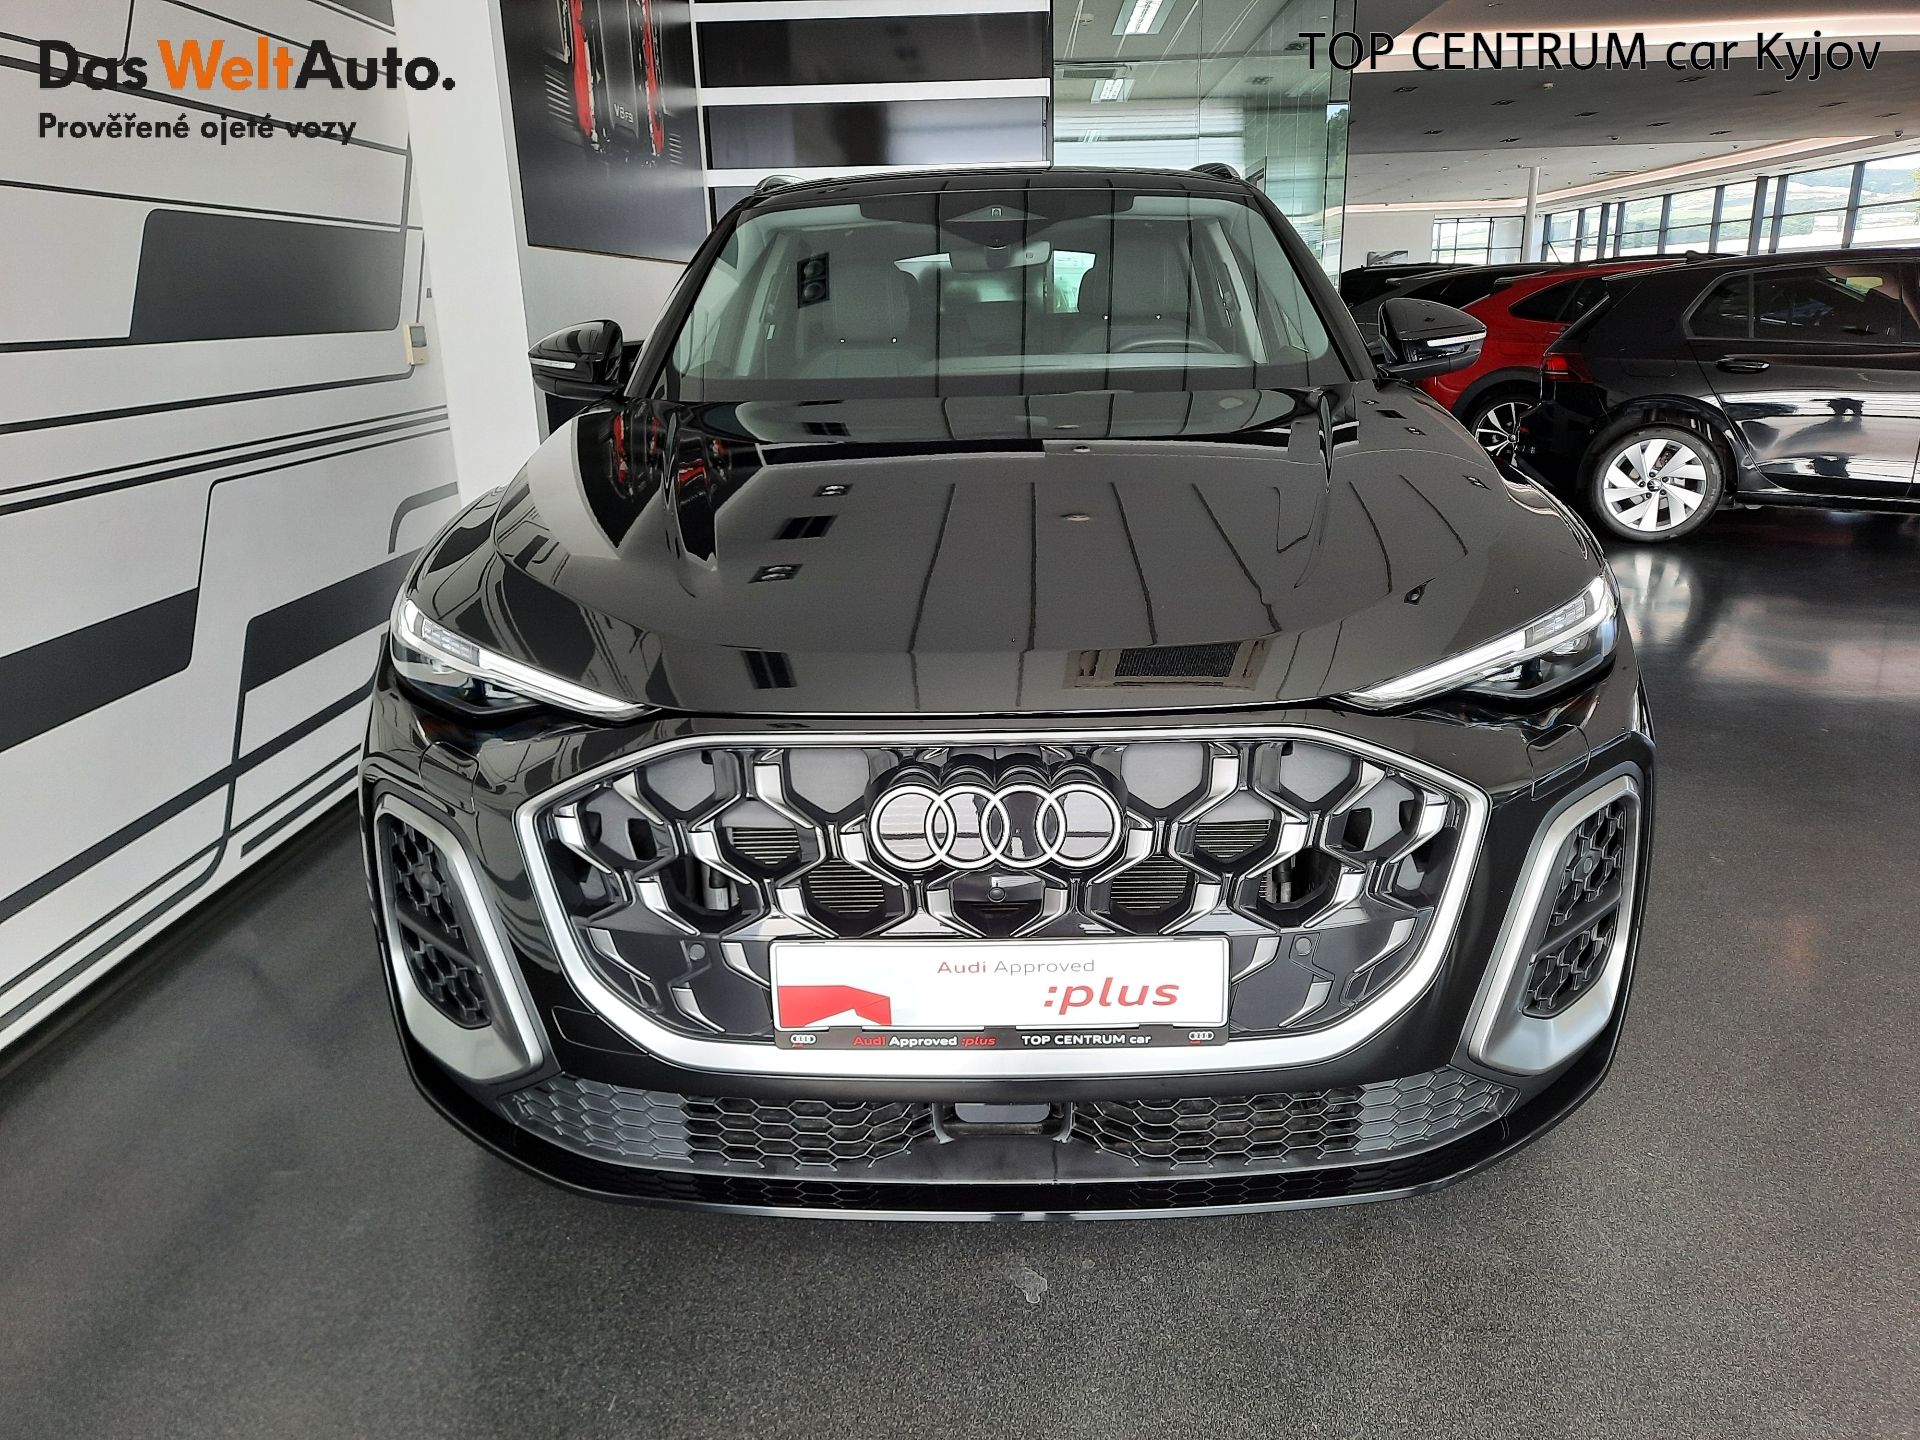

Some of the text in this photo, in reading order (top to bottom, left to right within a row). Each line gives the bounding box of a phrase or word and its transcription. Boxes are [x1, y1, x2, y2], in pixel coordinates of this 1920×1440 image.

[937, 959, 1096, 976] Audi Approved
[1043, 977, 1180, 1016] :plus
[853, 1036, 996, 1048] Audi Approved :plus
[1021, 1034, 1151, 1045] TOP CENTRUM car
